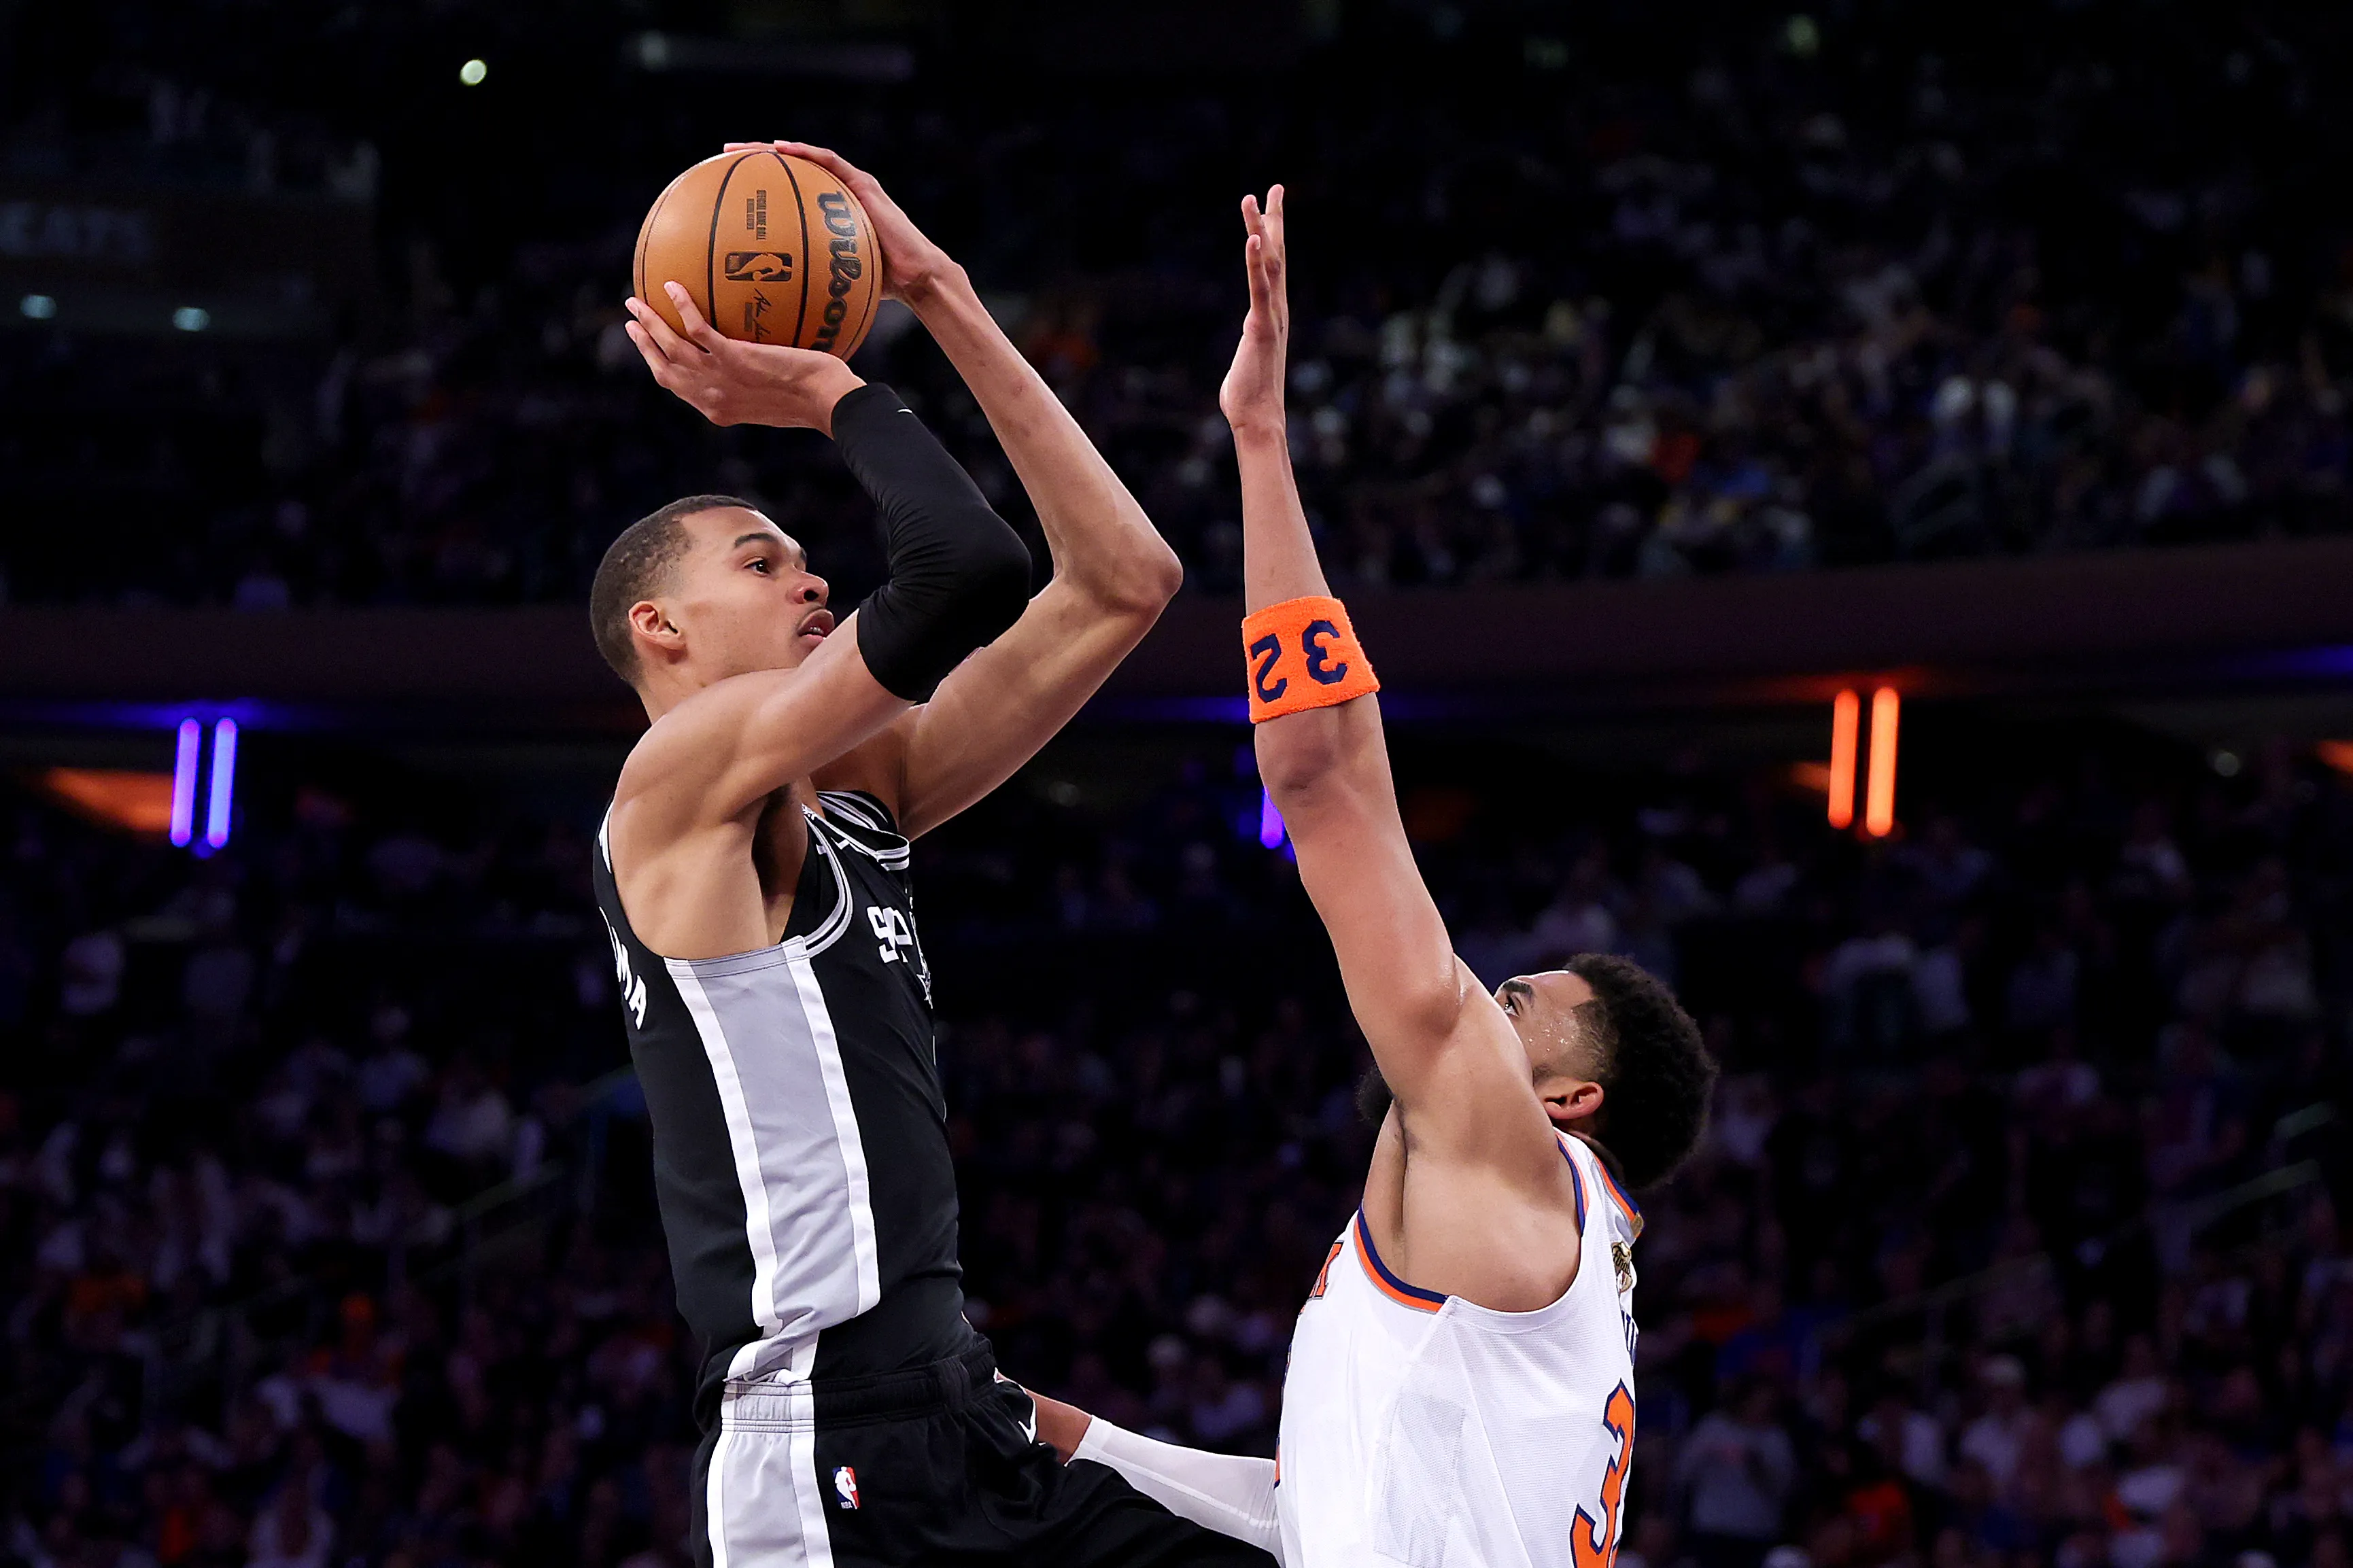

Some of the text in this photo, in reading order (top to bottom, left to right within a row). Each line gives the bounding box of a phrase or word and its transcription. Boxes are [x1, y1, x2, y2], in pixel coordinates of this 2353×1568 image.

[811, 190, 862, 352] Wilson
[1250, 620, 1348, 703] 32
[1570, 1378, 1634, 1568] 3
